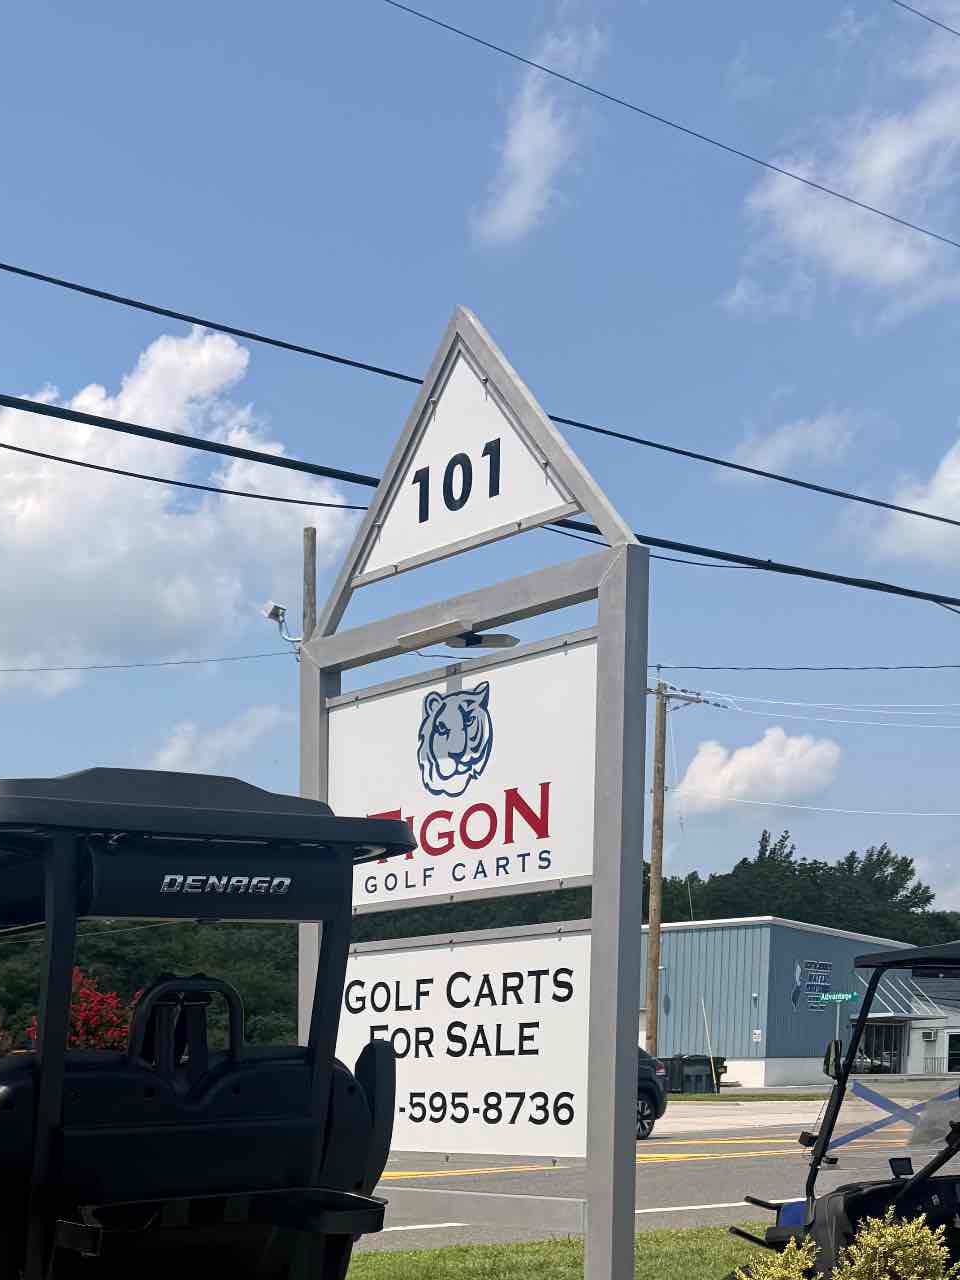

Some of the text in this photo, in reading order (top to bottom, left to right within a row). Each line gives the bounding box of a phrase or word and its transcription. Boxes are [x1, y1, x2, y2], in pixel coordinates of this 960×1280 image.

[411, 438, 501, 524] 101
[160, 874, 292, 894] DENAGO
[365, 850, 553, 894] GOLF CARTS
[344, 967, 574, 1014] GOLF CARTS
[446, 1020, 540, 1057] SALE
